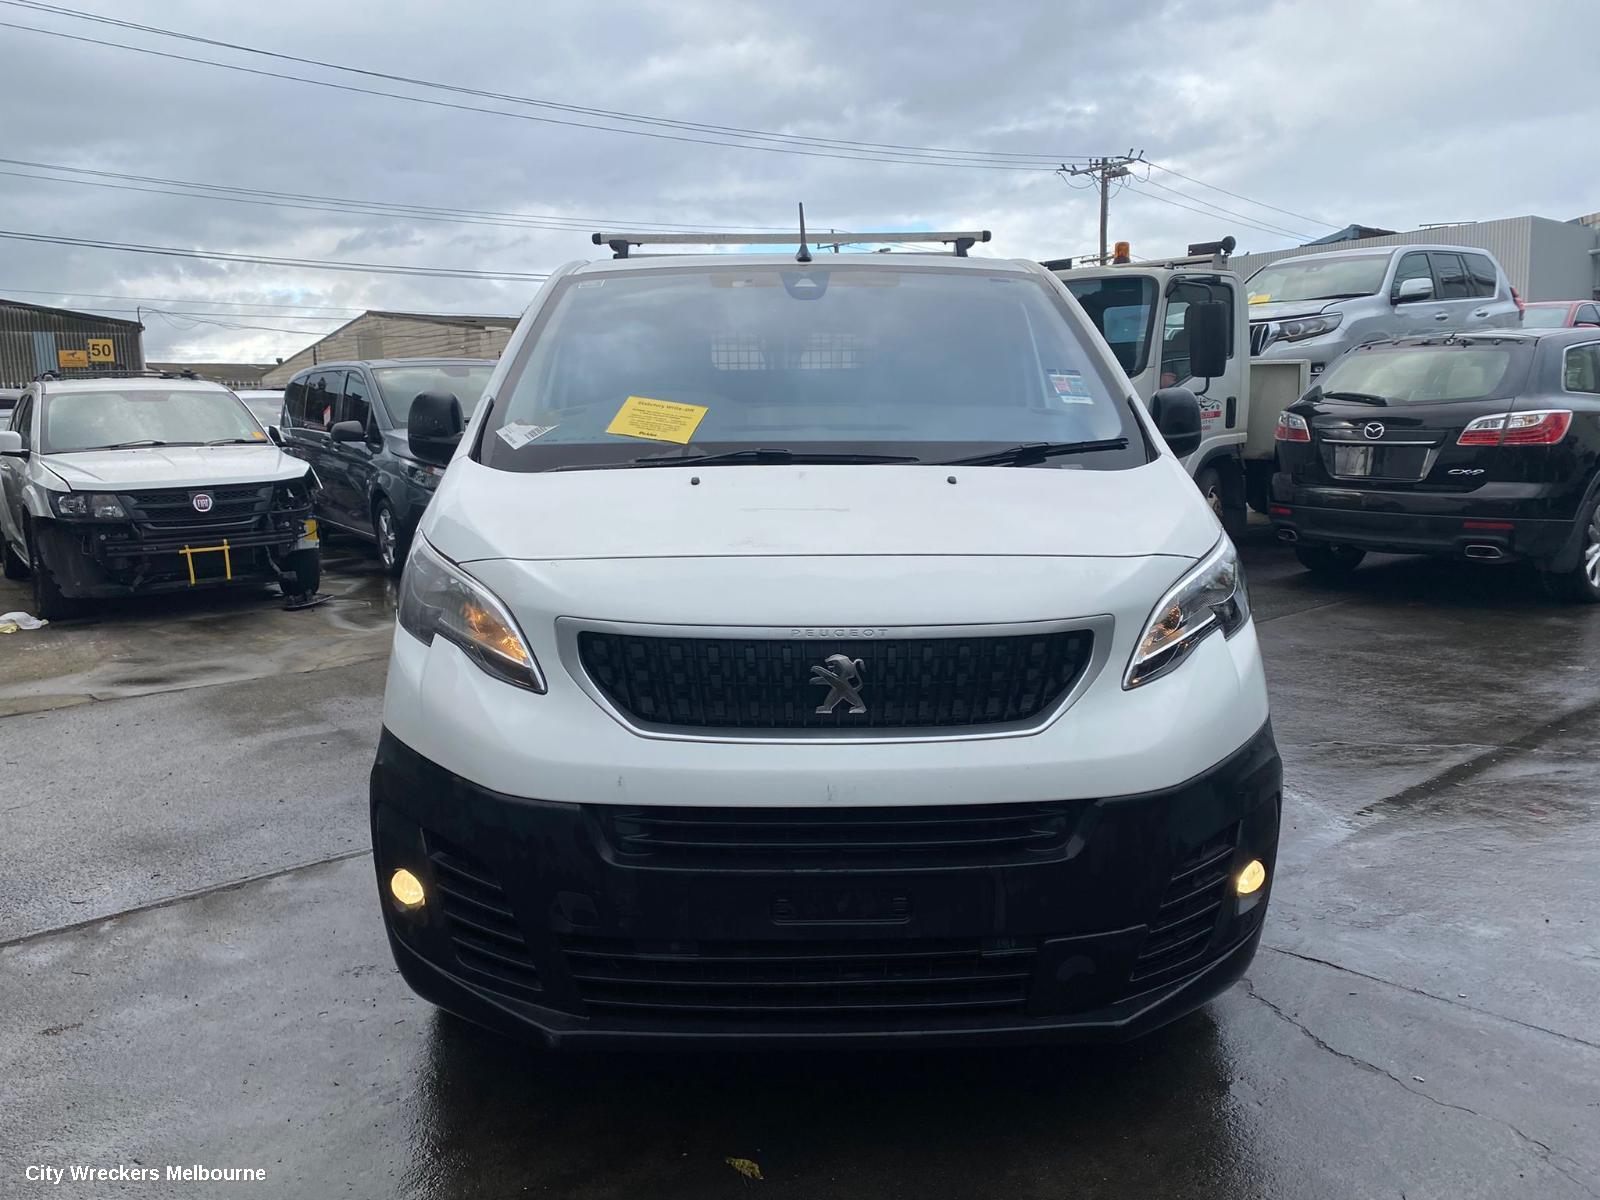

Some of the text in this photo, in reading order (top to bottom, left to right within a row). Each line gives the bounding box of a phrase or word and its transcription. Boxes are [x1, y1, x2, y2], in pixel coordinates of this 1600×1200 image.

[91, 343, 112, 357] 50
[1448, 468, 1486, 476] CX-9
[791, 628, 889, 638] PEUGEOT
